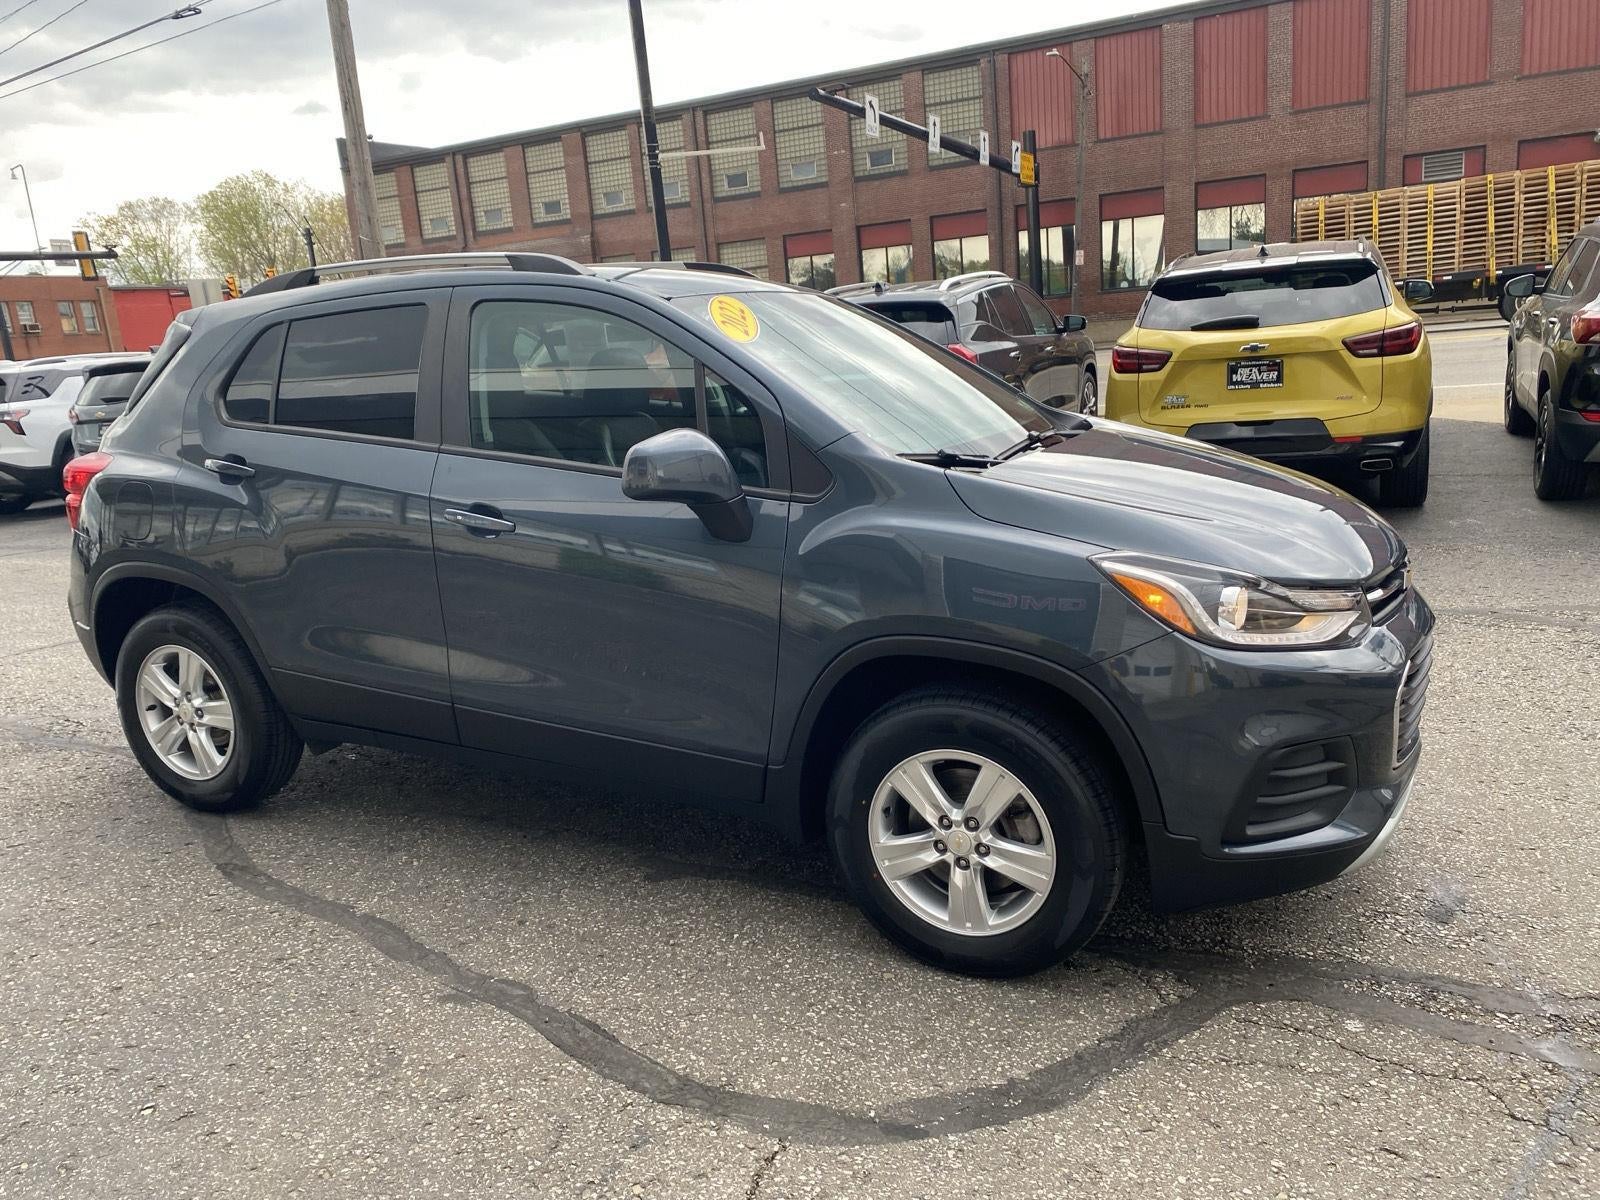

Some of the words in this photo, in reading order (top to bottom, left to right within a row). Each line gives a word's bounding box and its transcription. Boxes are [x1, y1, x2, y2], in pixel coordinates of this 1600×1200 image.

[717, 300, 750, 337] 2022
[1237, 366, 1259, 374] RICK
[1232, 371, 1278, 382] WEAVER
